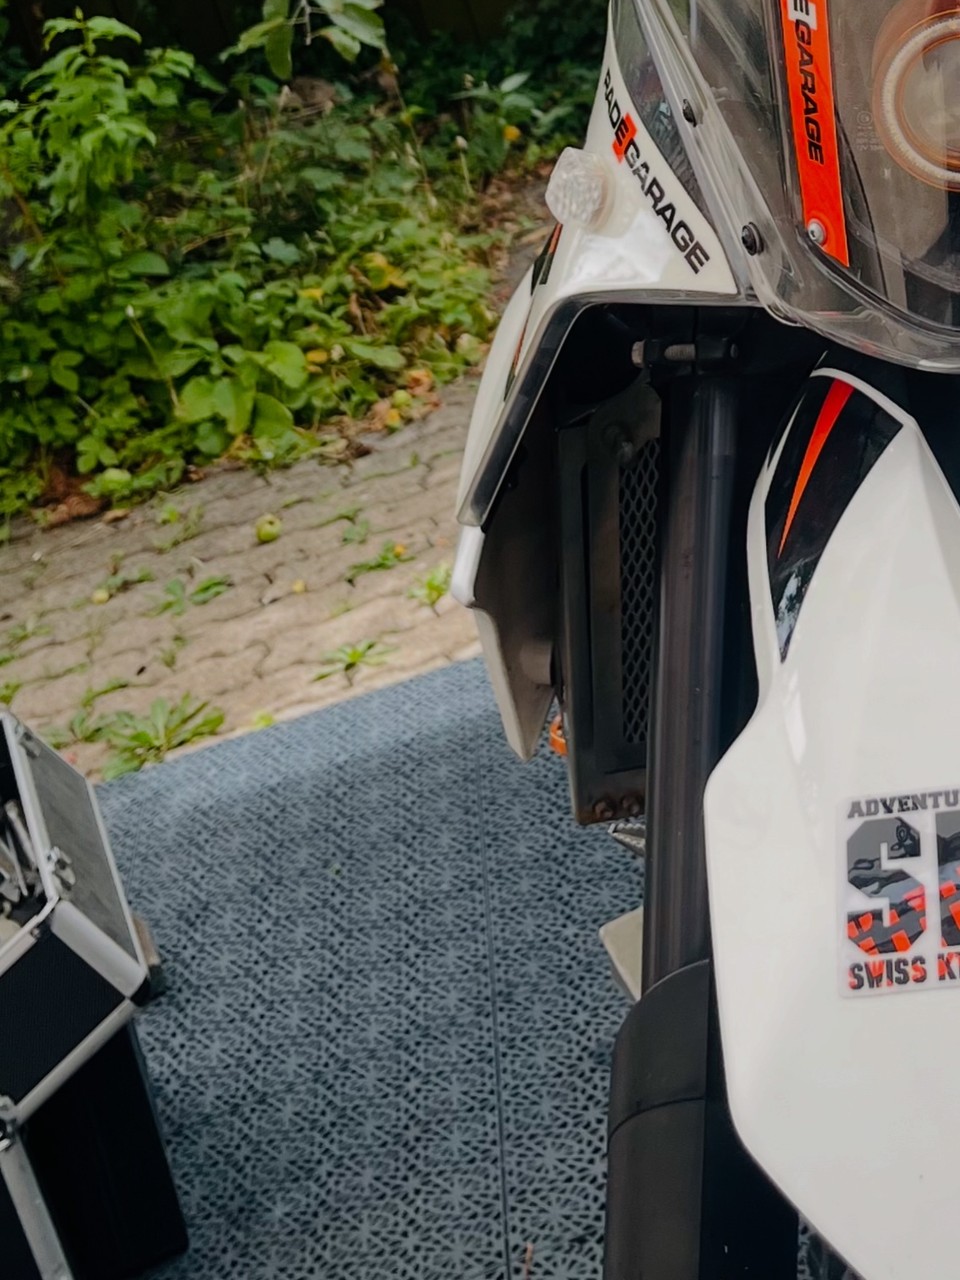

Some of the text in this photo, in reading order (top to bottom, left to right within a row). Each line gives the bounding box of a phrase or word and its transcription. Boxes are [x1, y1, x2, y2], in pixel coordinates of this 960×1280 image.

[794, 18, 825, 166] GARAGE
[603, 67, 711, 275] RADE GARAGE
[848, 954, 928, 991] SWISS
